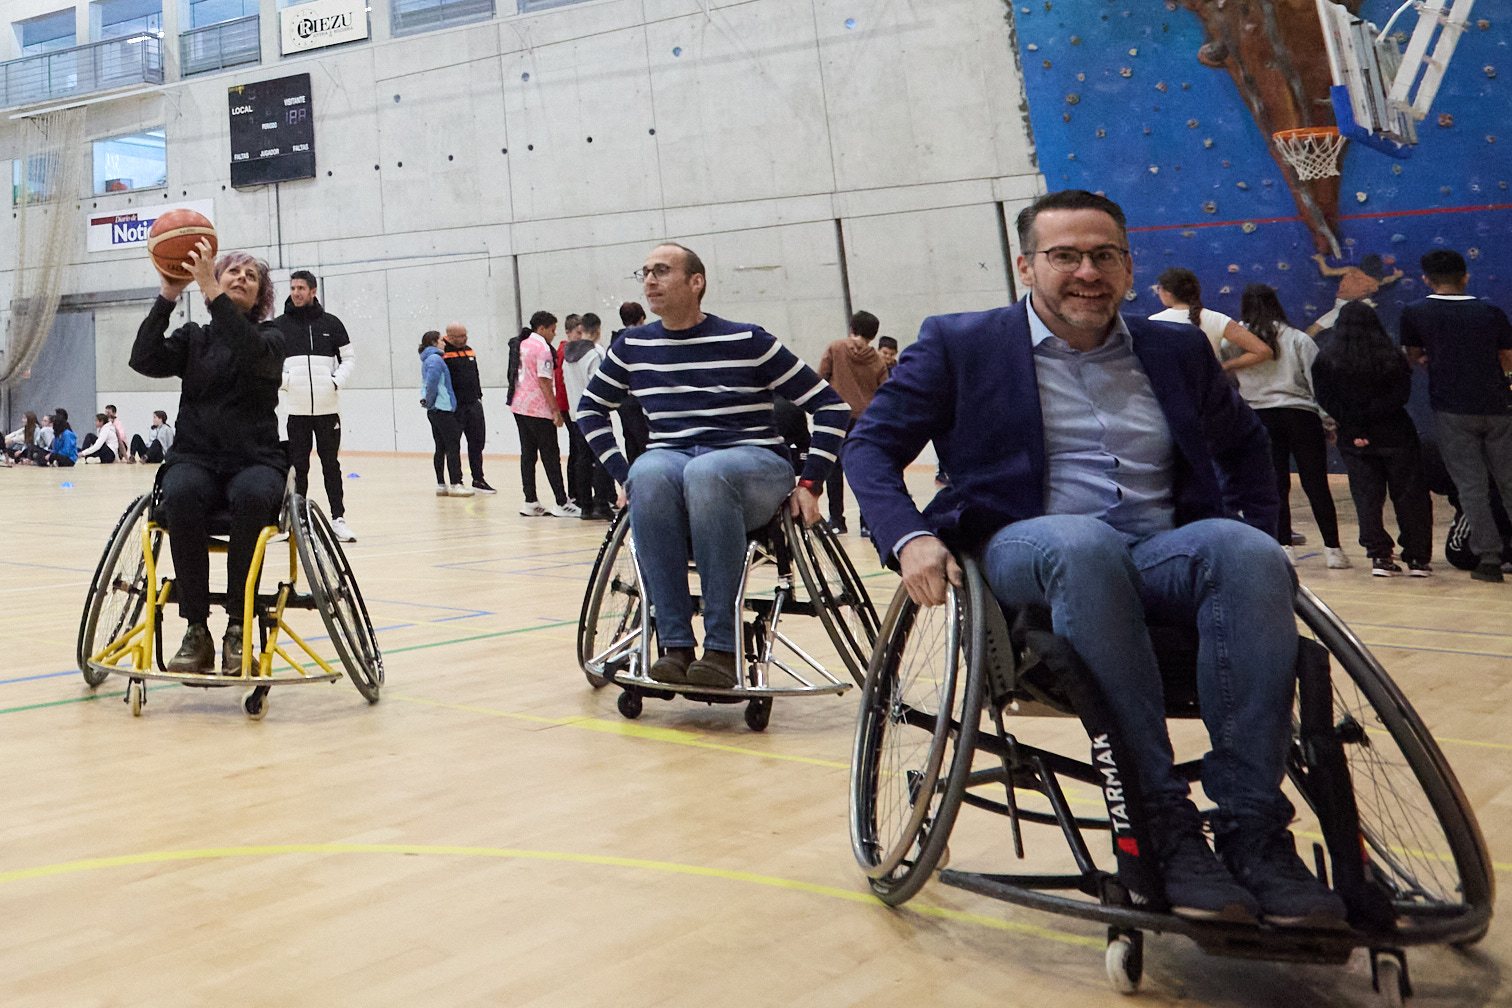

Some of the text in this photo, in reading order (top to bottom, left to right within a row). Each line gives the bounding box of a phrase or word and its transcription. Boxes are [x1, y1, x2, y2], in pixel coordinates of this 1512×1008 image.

[299, 12, 353, 37] RIEZU
[284, 95, 305, 106] VISITANTE
[232, 105, 253, 115] LOCAL
[292, 143, 309, 152] FALTAS
[234, 152, 249, 160] FALTAS
[260, 148, 280, 157] JUGADOR
[115, 215, 131, 223] Diario
[1093, 733, 1132, 833] TARMAK
